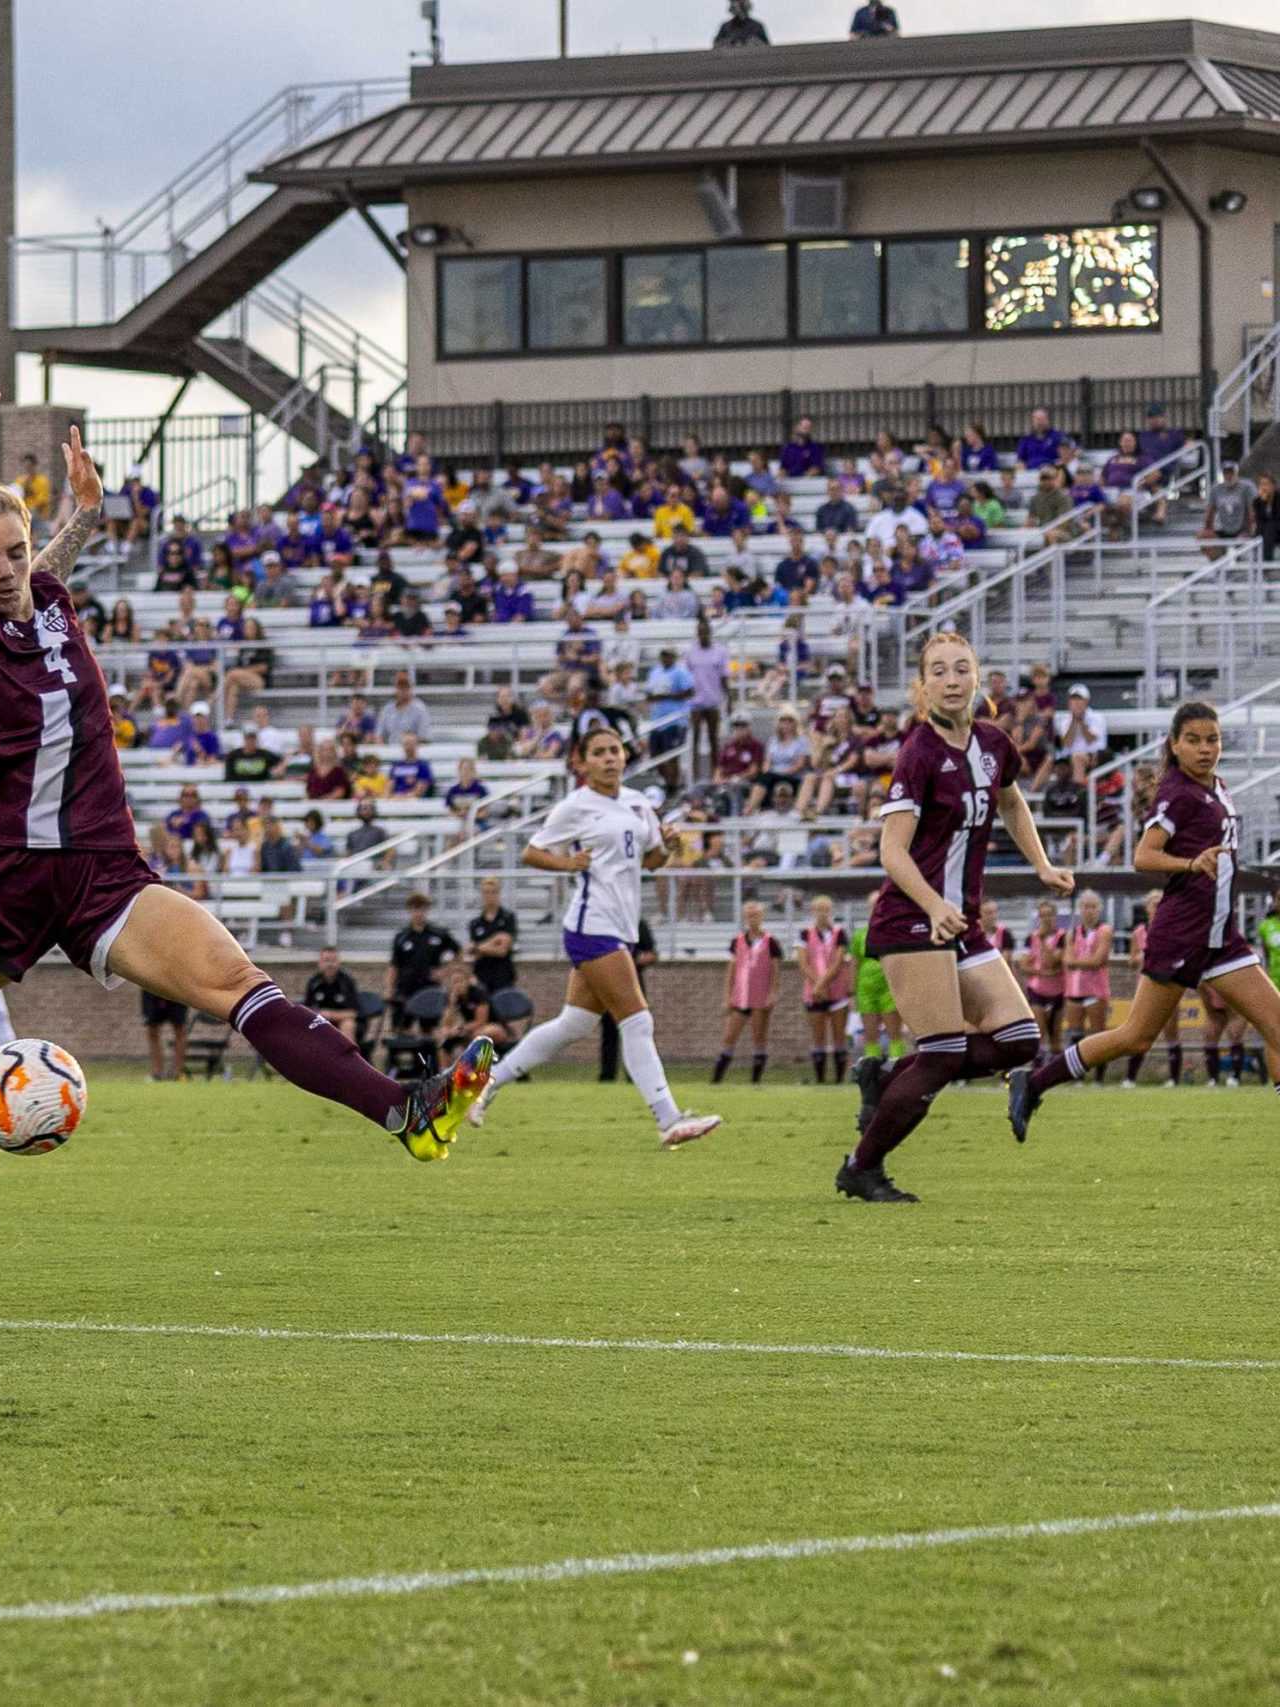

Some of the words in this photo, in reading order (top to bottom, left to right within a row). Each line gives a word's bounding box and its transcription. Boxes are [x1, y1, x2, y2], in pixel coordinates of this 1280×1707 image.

[44, 646, 77, 684] 4
[962, 789, 989, 827] 16
[624, 830, 634, 858] 8
